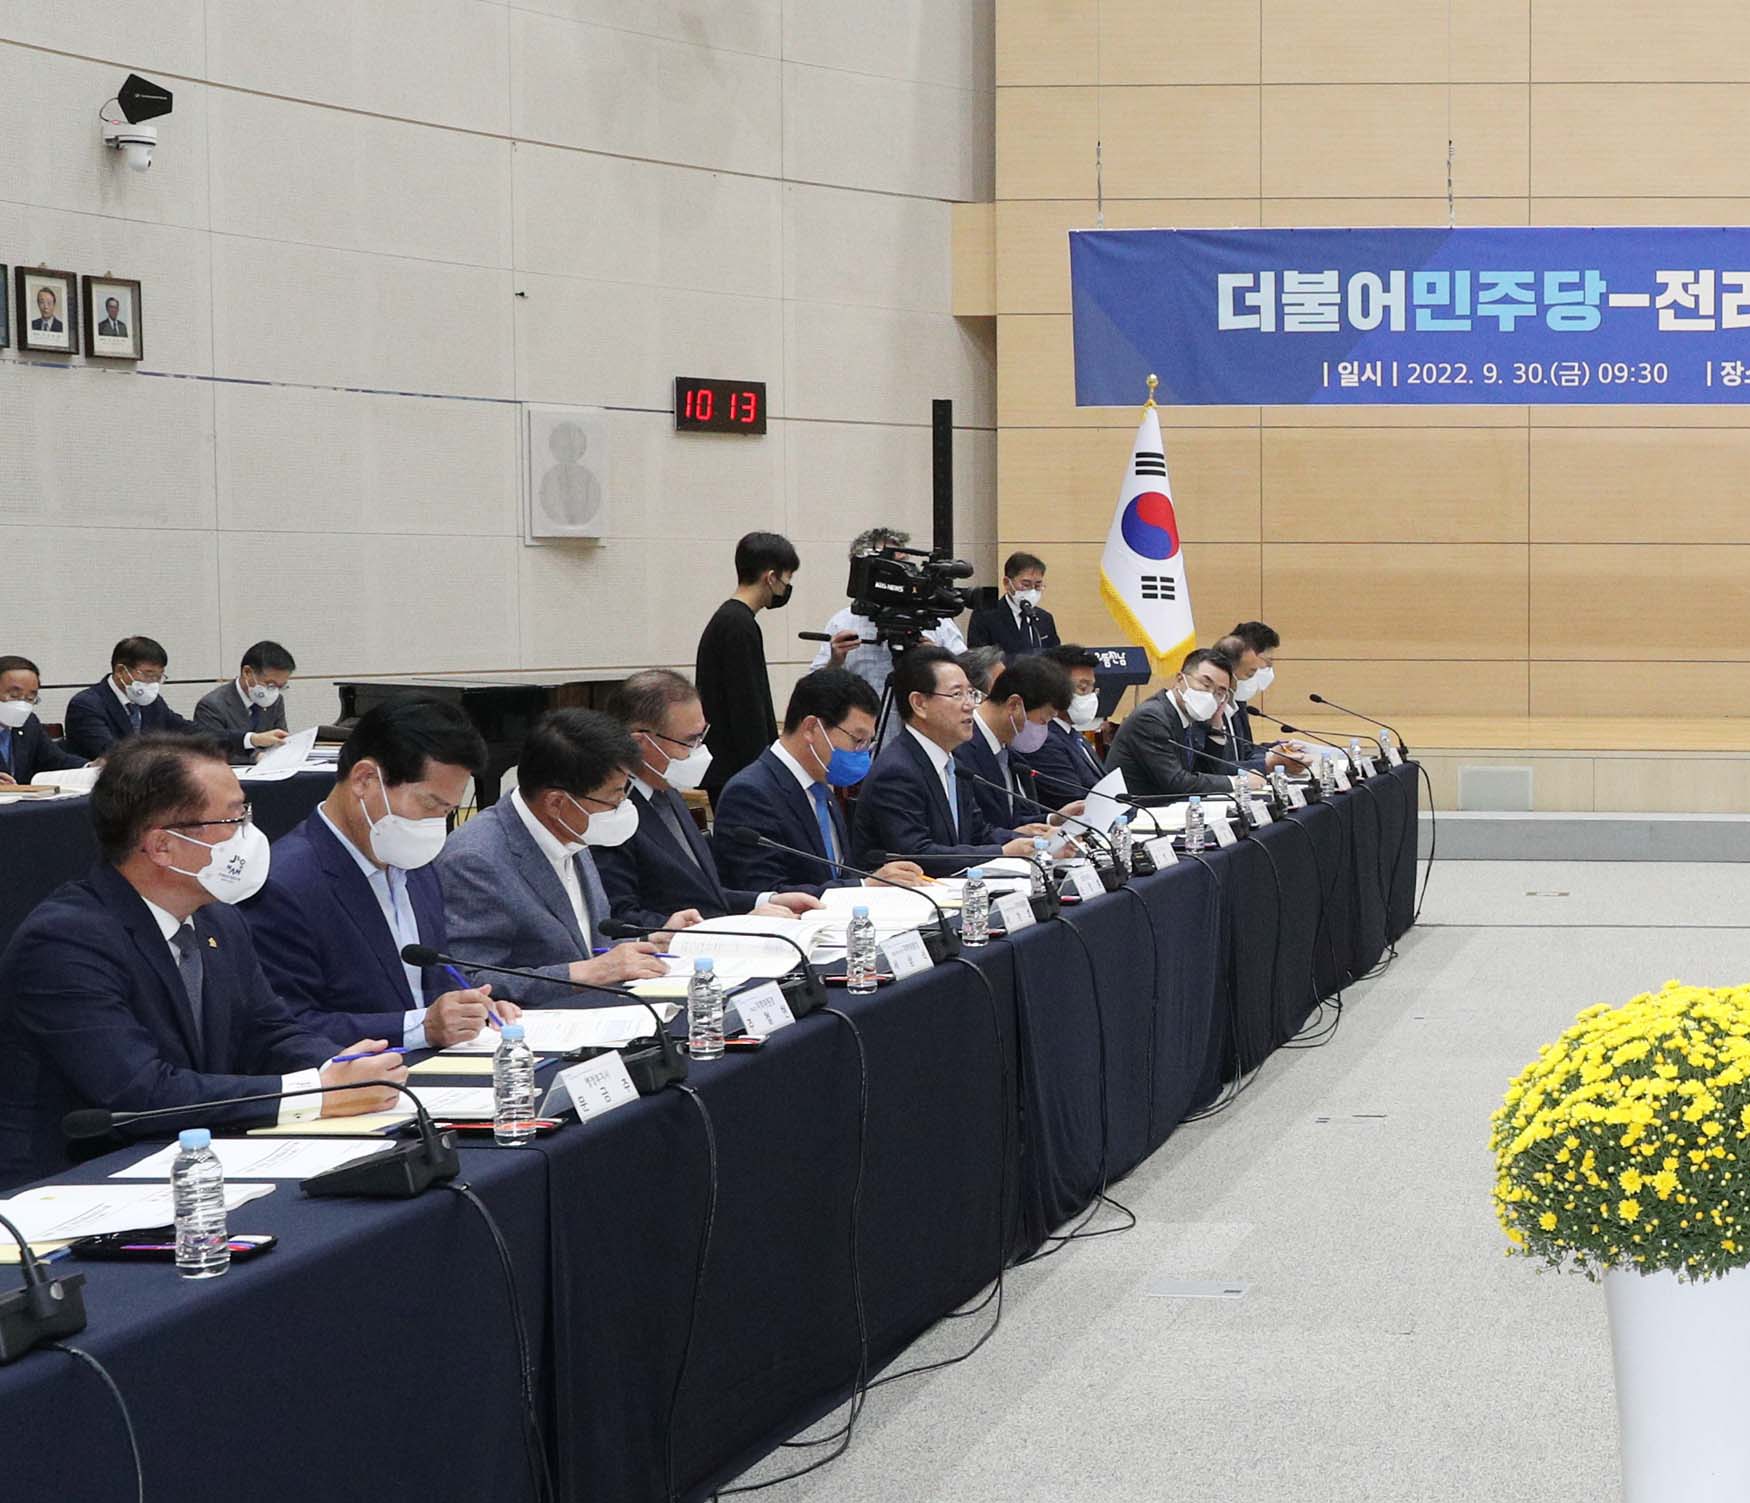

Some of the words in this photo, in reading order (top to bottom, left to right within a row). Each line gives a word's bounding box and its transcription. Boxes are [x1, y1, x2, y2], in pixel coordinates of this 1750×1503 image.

[1337, 360, 1382, 387] 일시
[1407, 362, 1474, 384] 2022.
[1482, 362, 1503, 384] 9.
[1512, 361, 1590, 387] 30.(금)
[1598, 362, 1668, 384] 09:30
[684, 388, 713, 420] 10
[729, 391, 757, 423] 13
